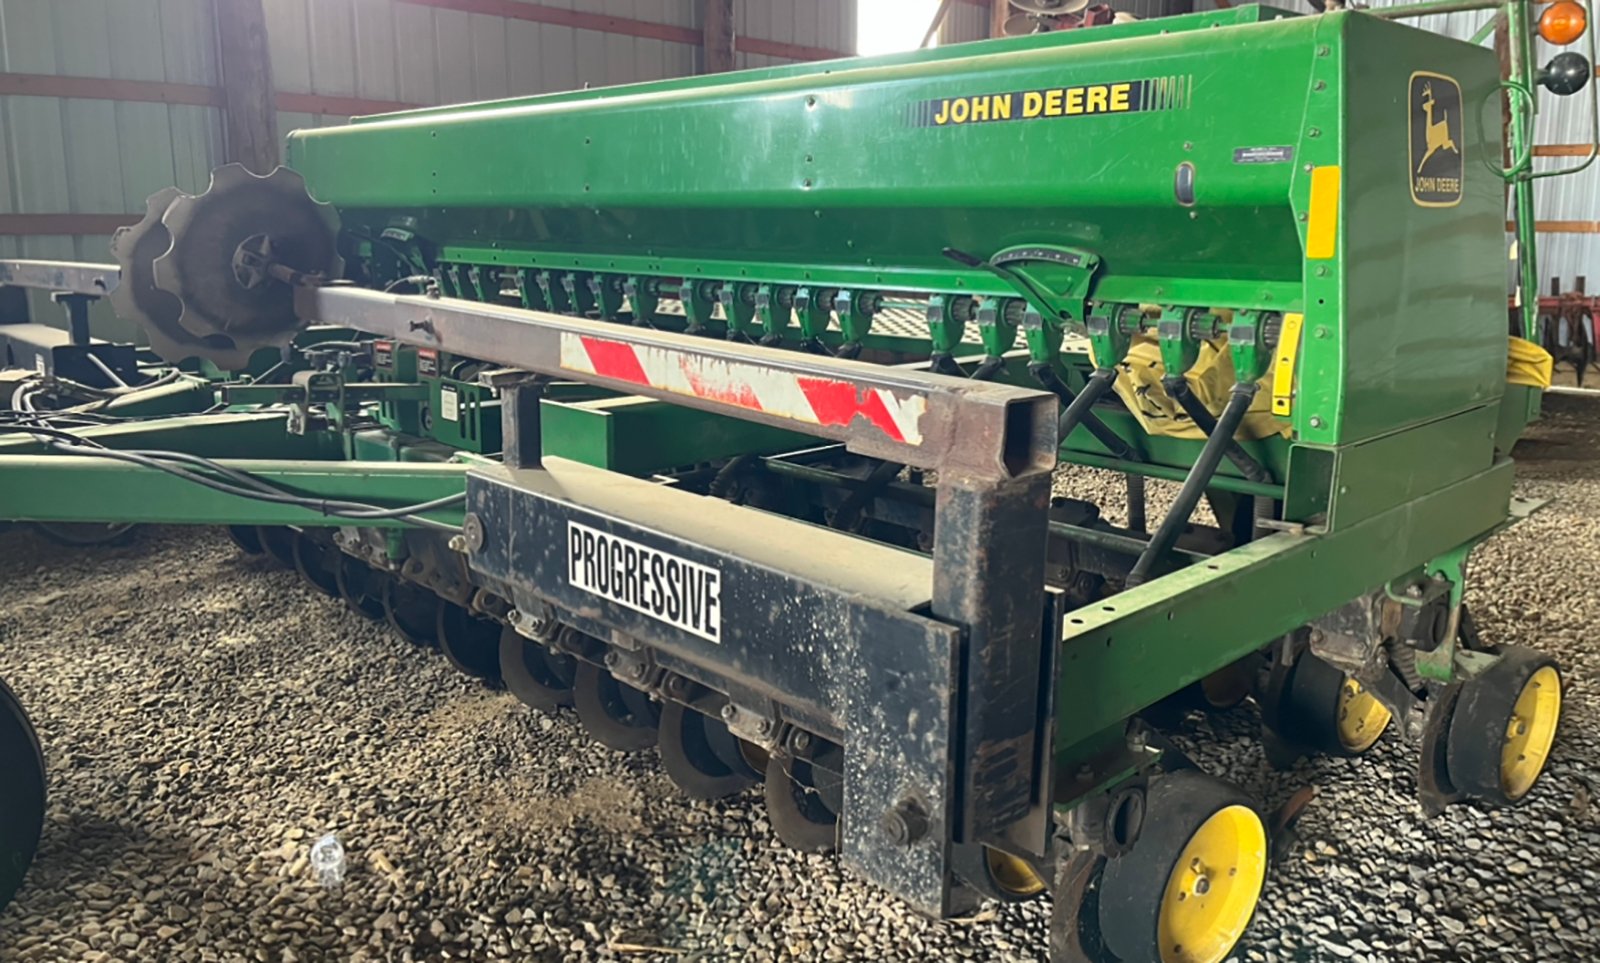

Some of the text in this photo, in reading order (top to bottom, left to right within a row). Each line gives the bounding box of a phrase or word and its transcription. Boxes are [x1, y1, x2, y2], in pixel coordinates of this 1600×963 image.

[934, 83, 1131, 125] JOHN DEERE
[1415, 177, 1459, 192] JOHN DEERE
[571, 526, 717, 637] PROGRESSIVE
